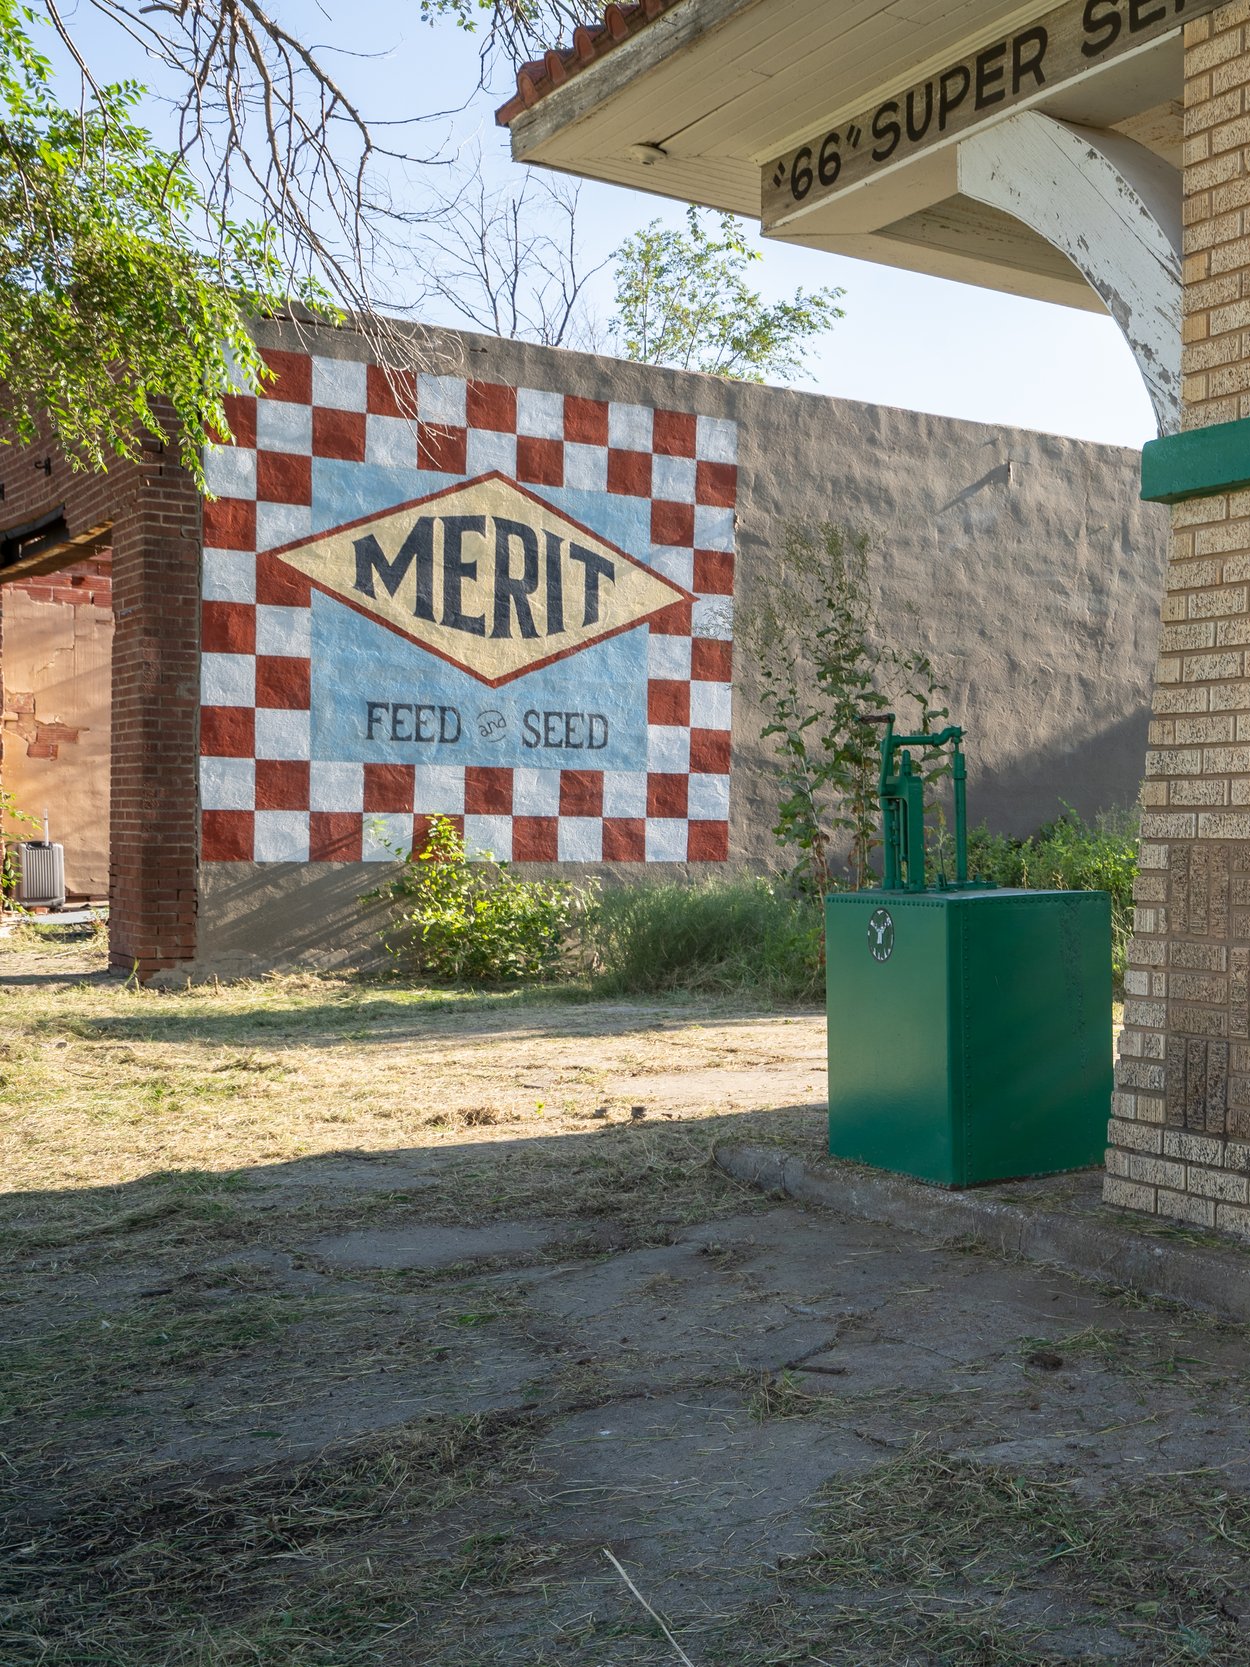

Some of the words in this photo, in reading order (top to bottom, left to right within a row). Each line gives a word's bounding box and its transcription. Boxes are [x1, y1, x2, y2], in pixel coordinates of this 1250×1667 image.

[872, 26, 1048, 162] SUPER
[1081, 0, 1185, 58] SE
[353, 514, 616, 640] MERIT
[365, 702, 462, 744] FEED
[478, 714, 507, 738] and
[522, 709, 610, 750] SEED
